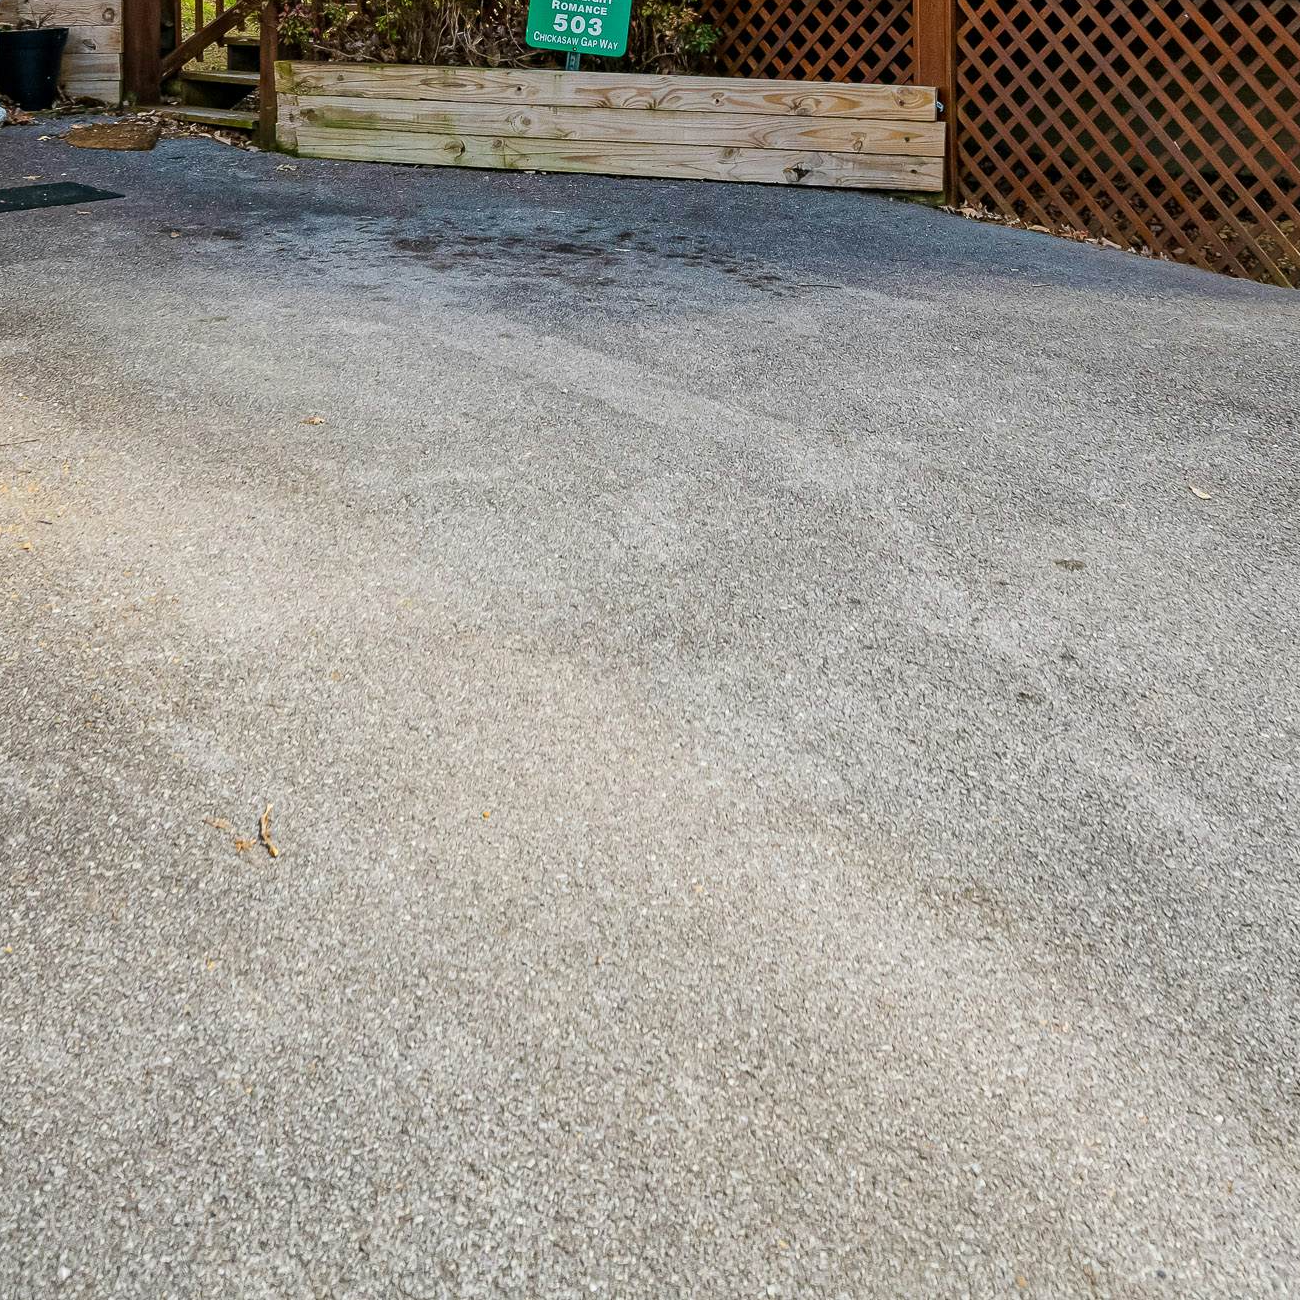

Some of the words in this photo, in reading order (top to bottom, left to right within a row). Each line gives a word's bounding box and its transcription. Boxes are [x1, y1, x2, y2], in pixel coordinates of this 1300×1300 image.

[551, 0, 608, 16] ROMANCE
[552, 13, 603, 36] 503
[533, 31, 579, 46] CHICKASAW
[580, 36, 598, 48] GAP
[599, 39, 619, 50] WAY
